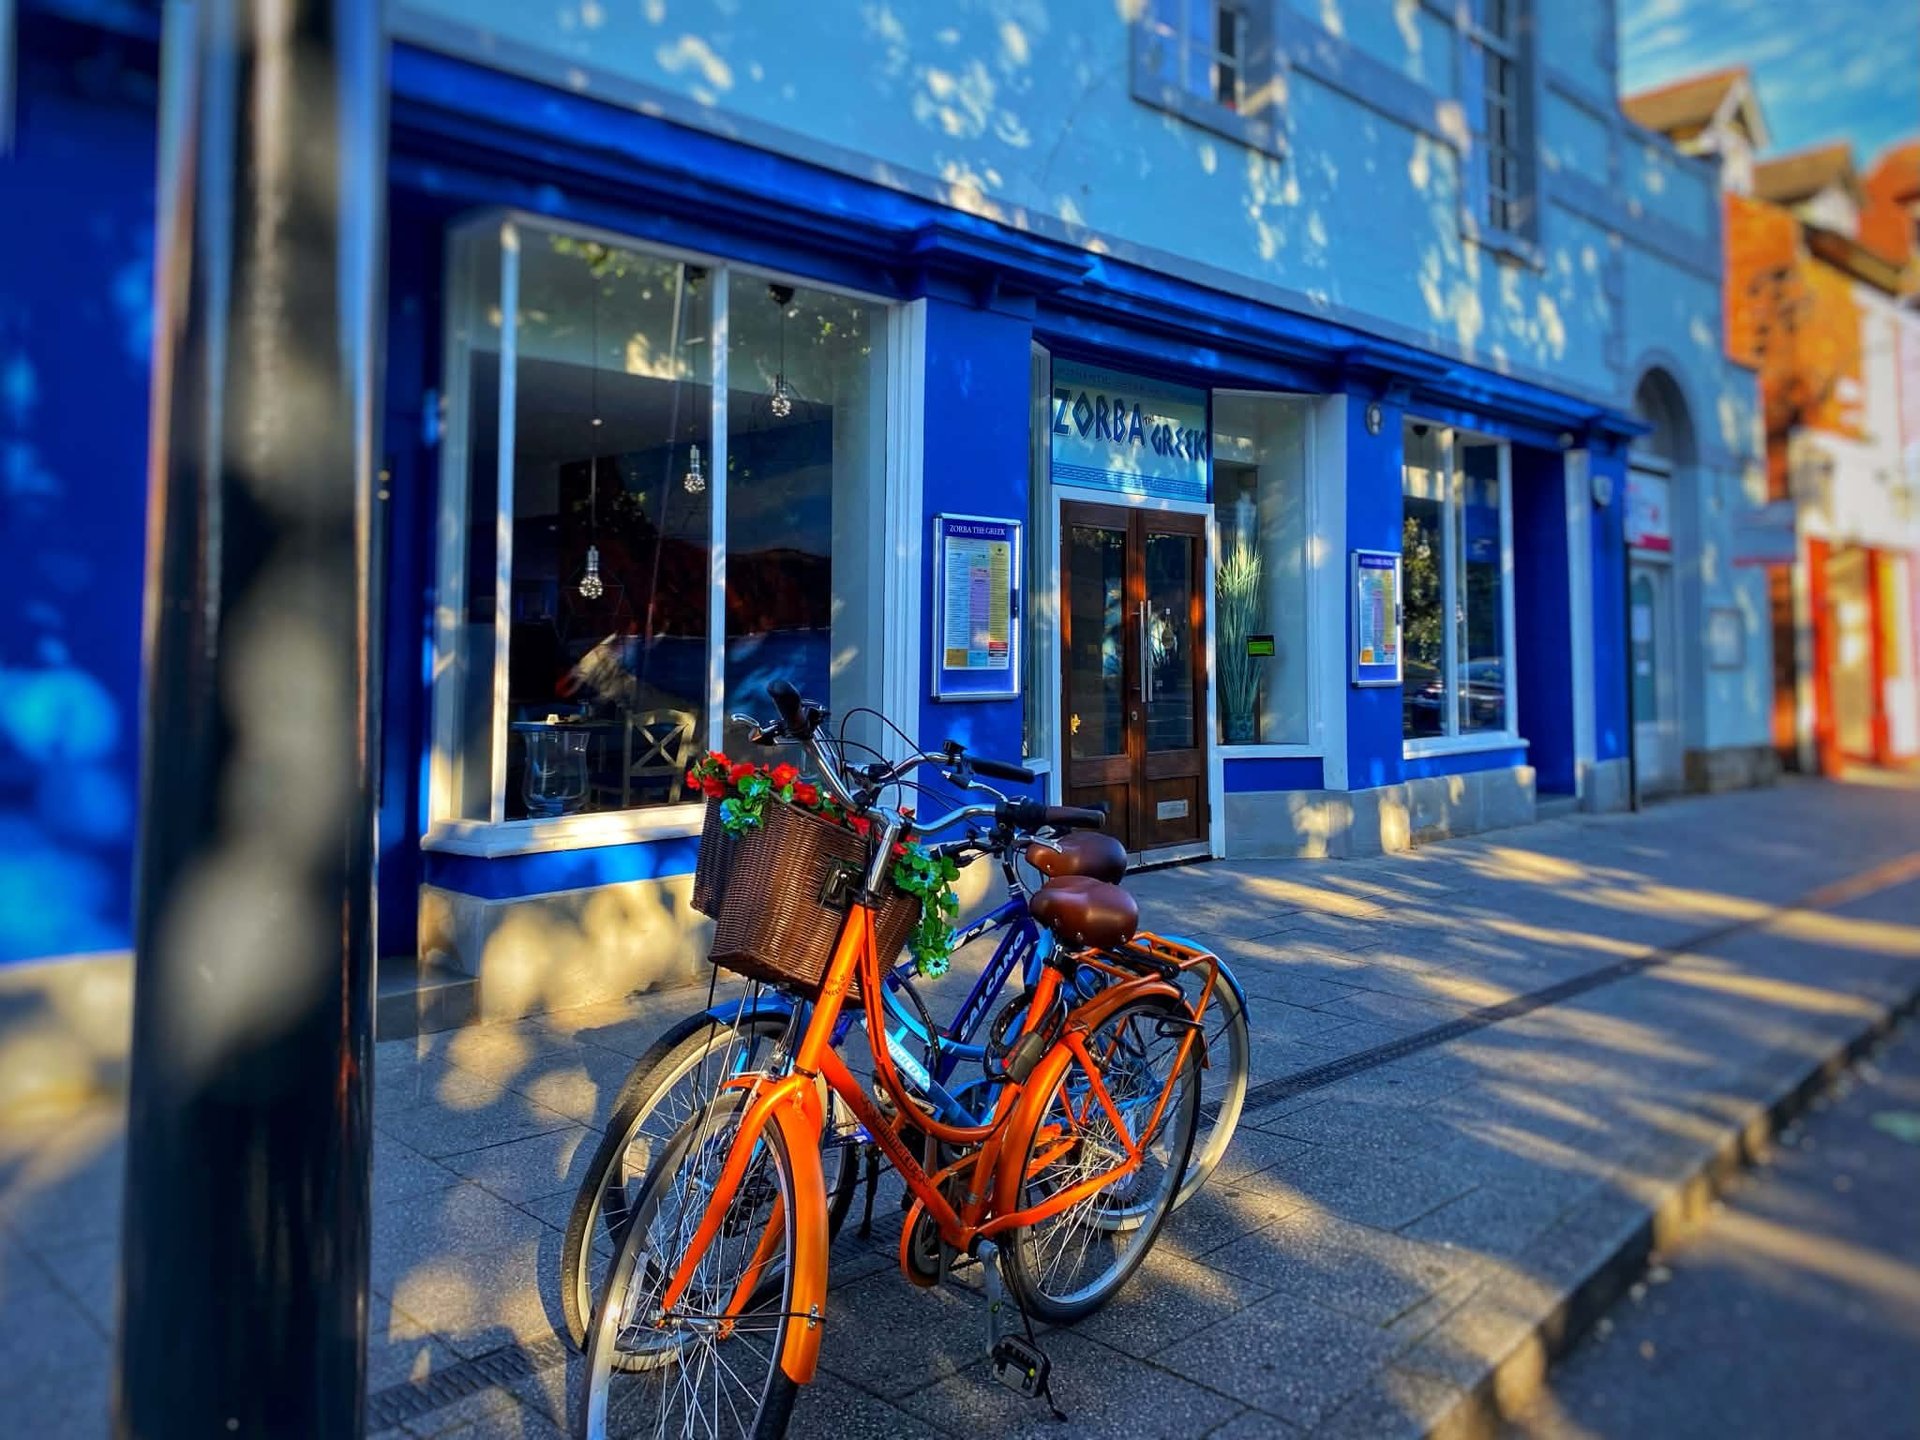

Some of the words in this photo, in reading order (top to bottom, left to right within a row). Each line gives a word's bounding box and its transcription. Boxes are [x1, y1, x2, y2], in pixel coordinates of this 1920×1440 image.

[1053, 387, 1146, 448] ZORBA
[1150, 423, 1206, 463] GREEK
[949, 524, 972, 534] ZORBA
[960, 929, 1025, 1042] SALCANO
